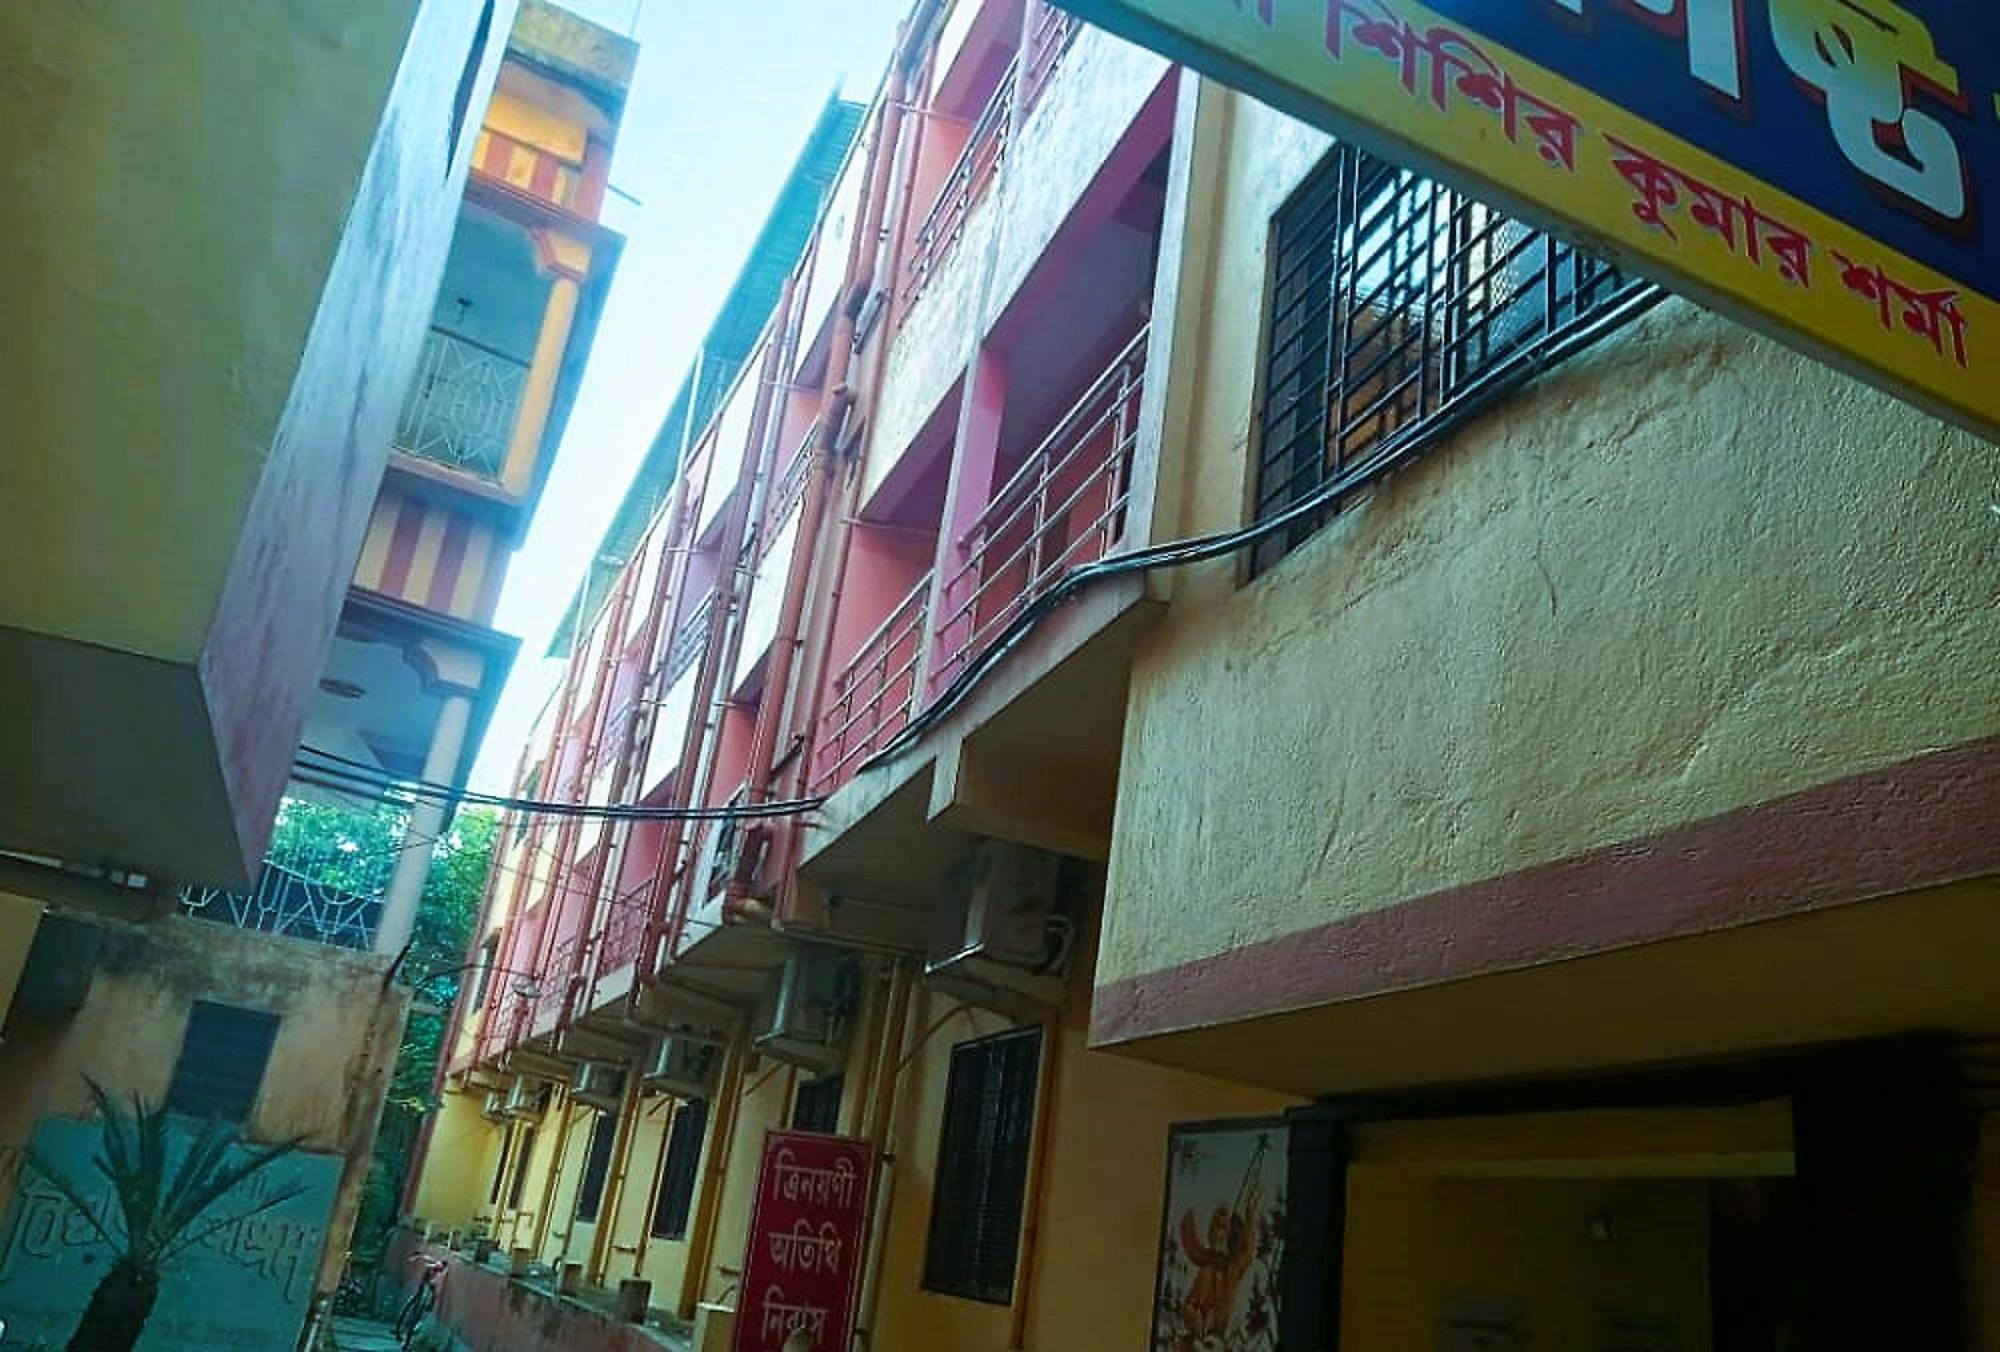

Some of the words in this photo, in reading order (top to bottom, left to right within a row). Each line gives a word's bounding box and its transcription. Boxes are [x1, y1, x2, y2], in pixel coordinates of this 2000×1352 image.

[1602, 131, 1813, 290] কুমার
[1828, 248, 1970, 370] শর্মা
[767, 1218, 842, 1275] অতিথি
